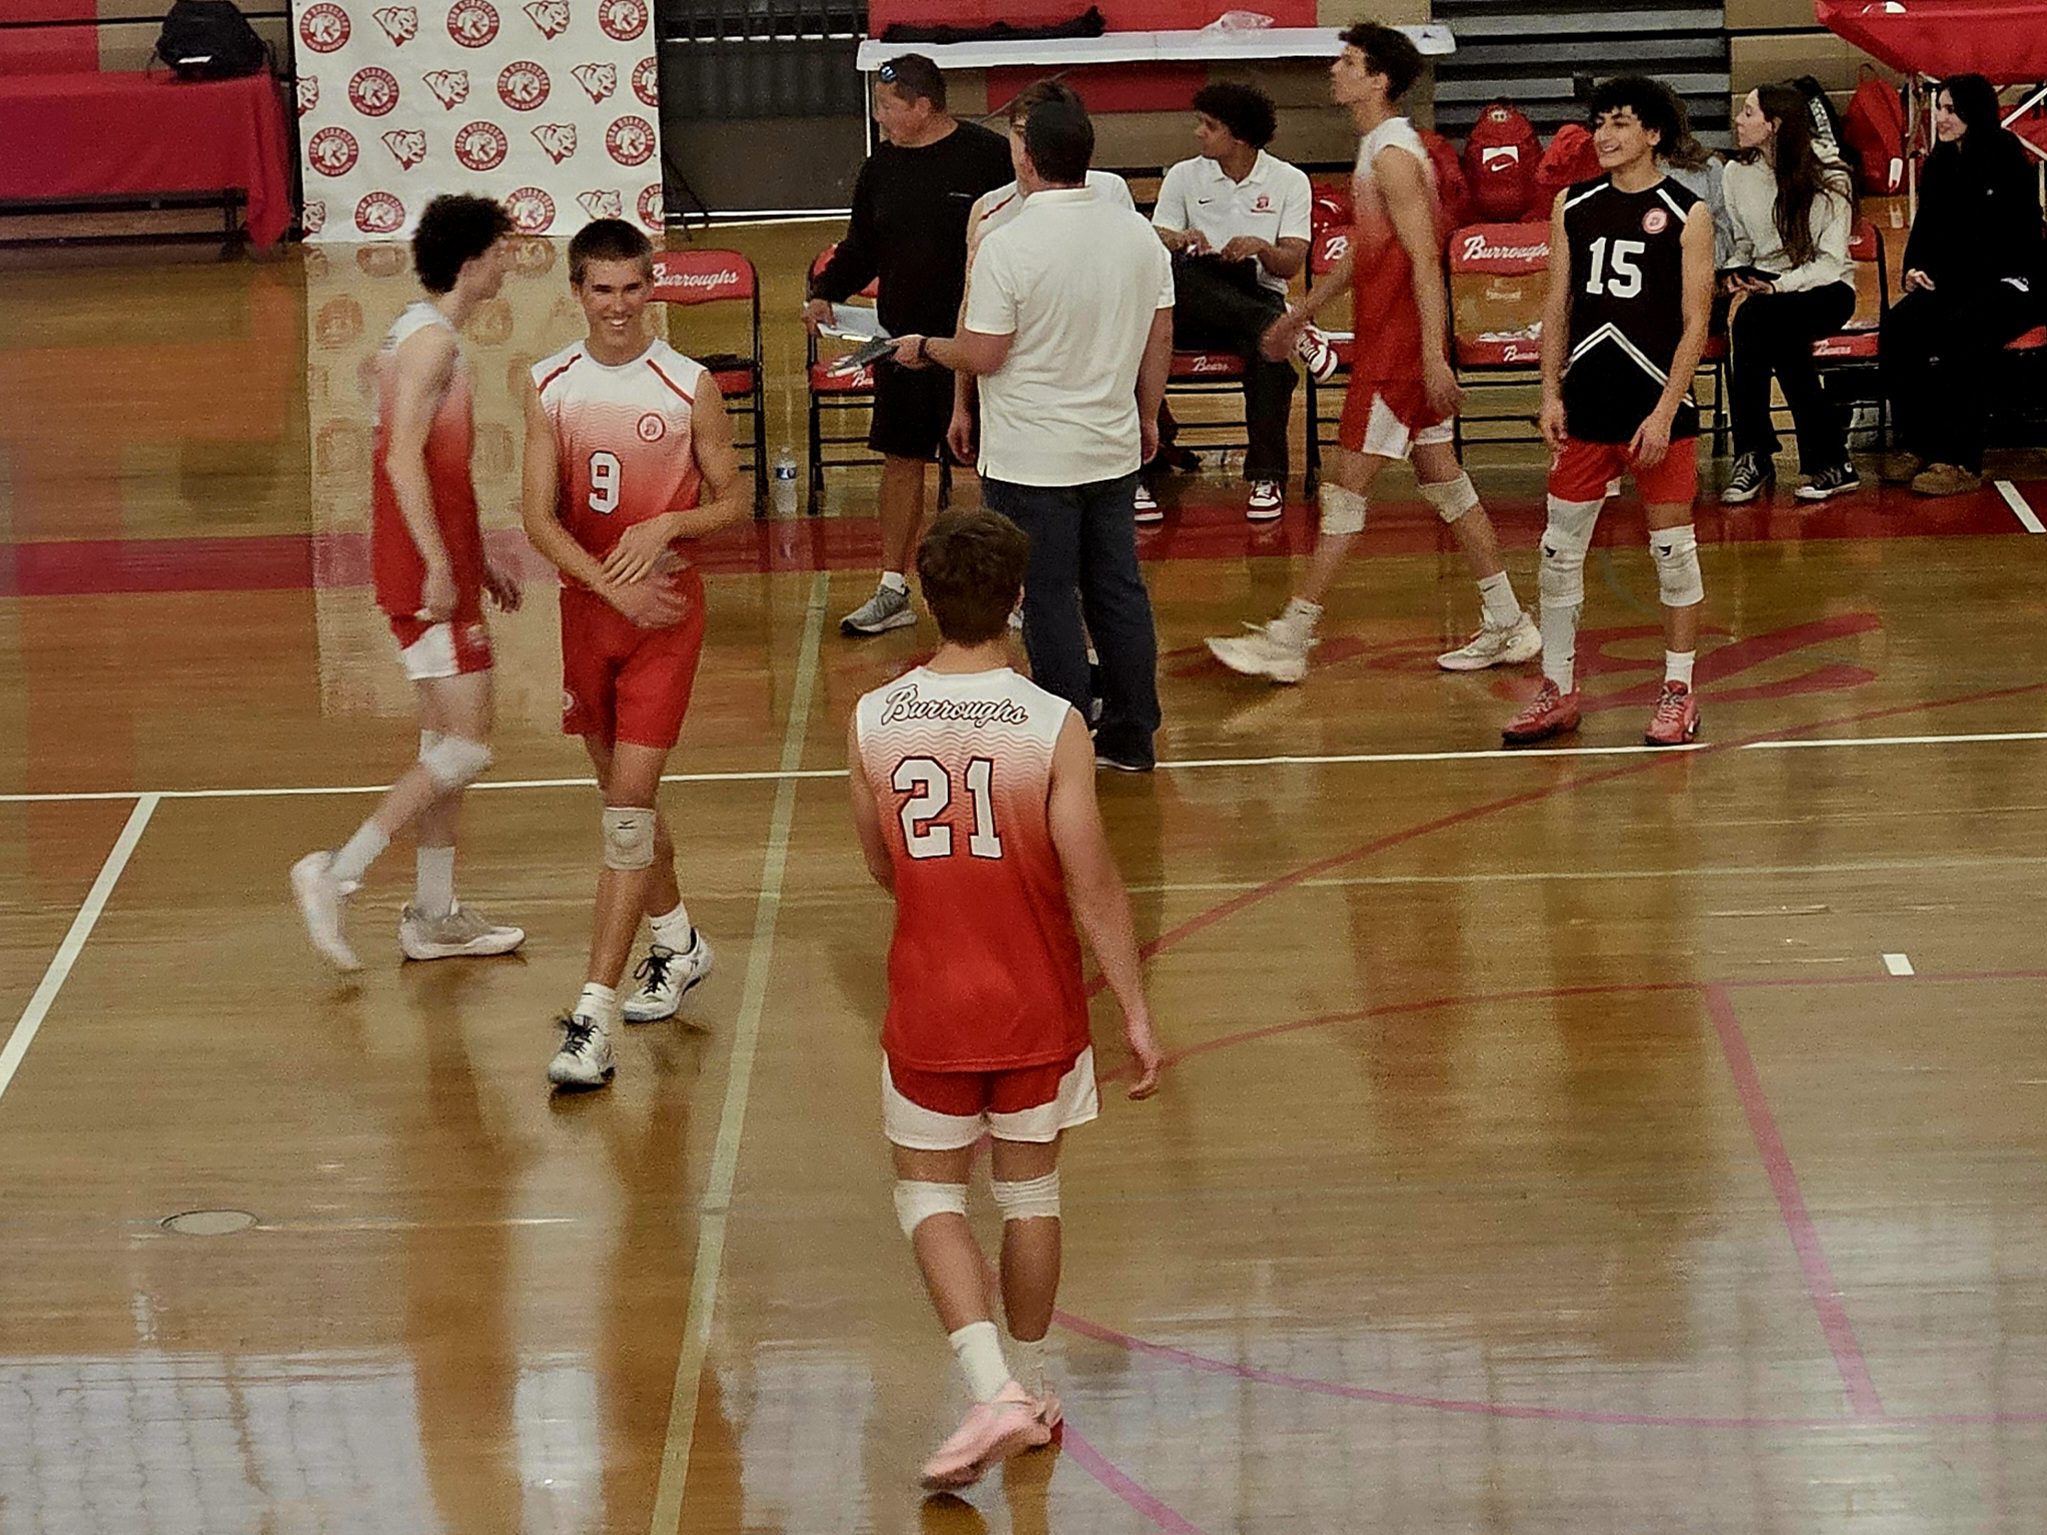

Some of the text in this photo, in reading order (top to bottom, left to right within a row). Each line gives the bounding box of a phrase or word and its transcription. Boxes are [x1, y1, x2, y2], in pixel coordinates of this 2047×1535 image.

[1462, 234, 1552, 262] Burrough
[1586, 236, 1645, 298] 15
[652, 262, 739, 290] Burroughs
[589, 450, 622, 515] 9
[881, 684, 1028, 728] Burroughs
[891, 756, 1003, 860] 21
